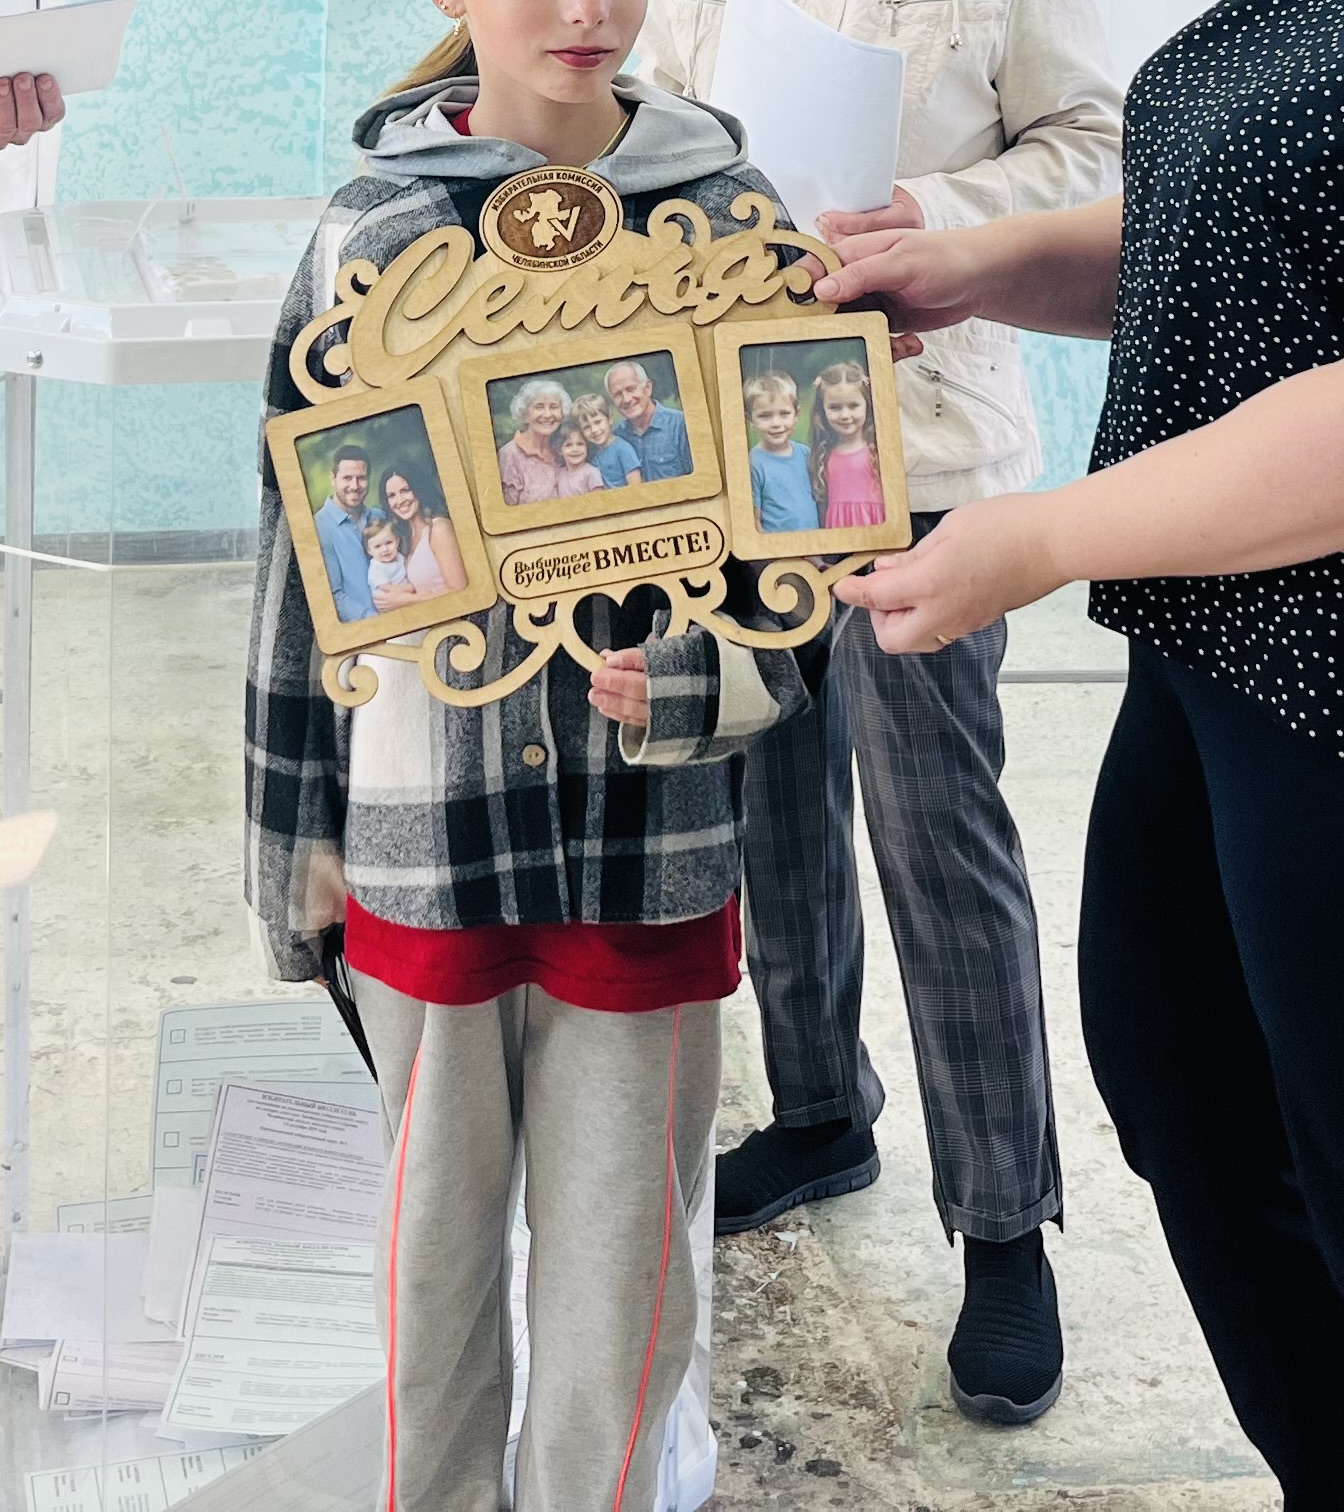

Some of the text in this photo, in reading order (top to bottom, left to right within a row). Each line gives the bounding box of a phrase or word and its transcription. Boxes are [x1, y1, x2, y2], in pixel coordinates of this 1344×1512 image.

[491, 172, 603, 212] ИЗБИРАТЕЛЬНАЯ КОМИССИЯ
[512, 240, 604, 269] ЧЕЛЯБИНСКОЙ ОБЛАСТИ
[350, 224, 786, 388] Семья
[514, 551, 590, 574] Выбираем
[593, 530, 711, 571] ВМЕСТЕ!
[515, 561, 591, 588] будущее
